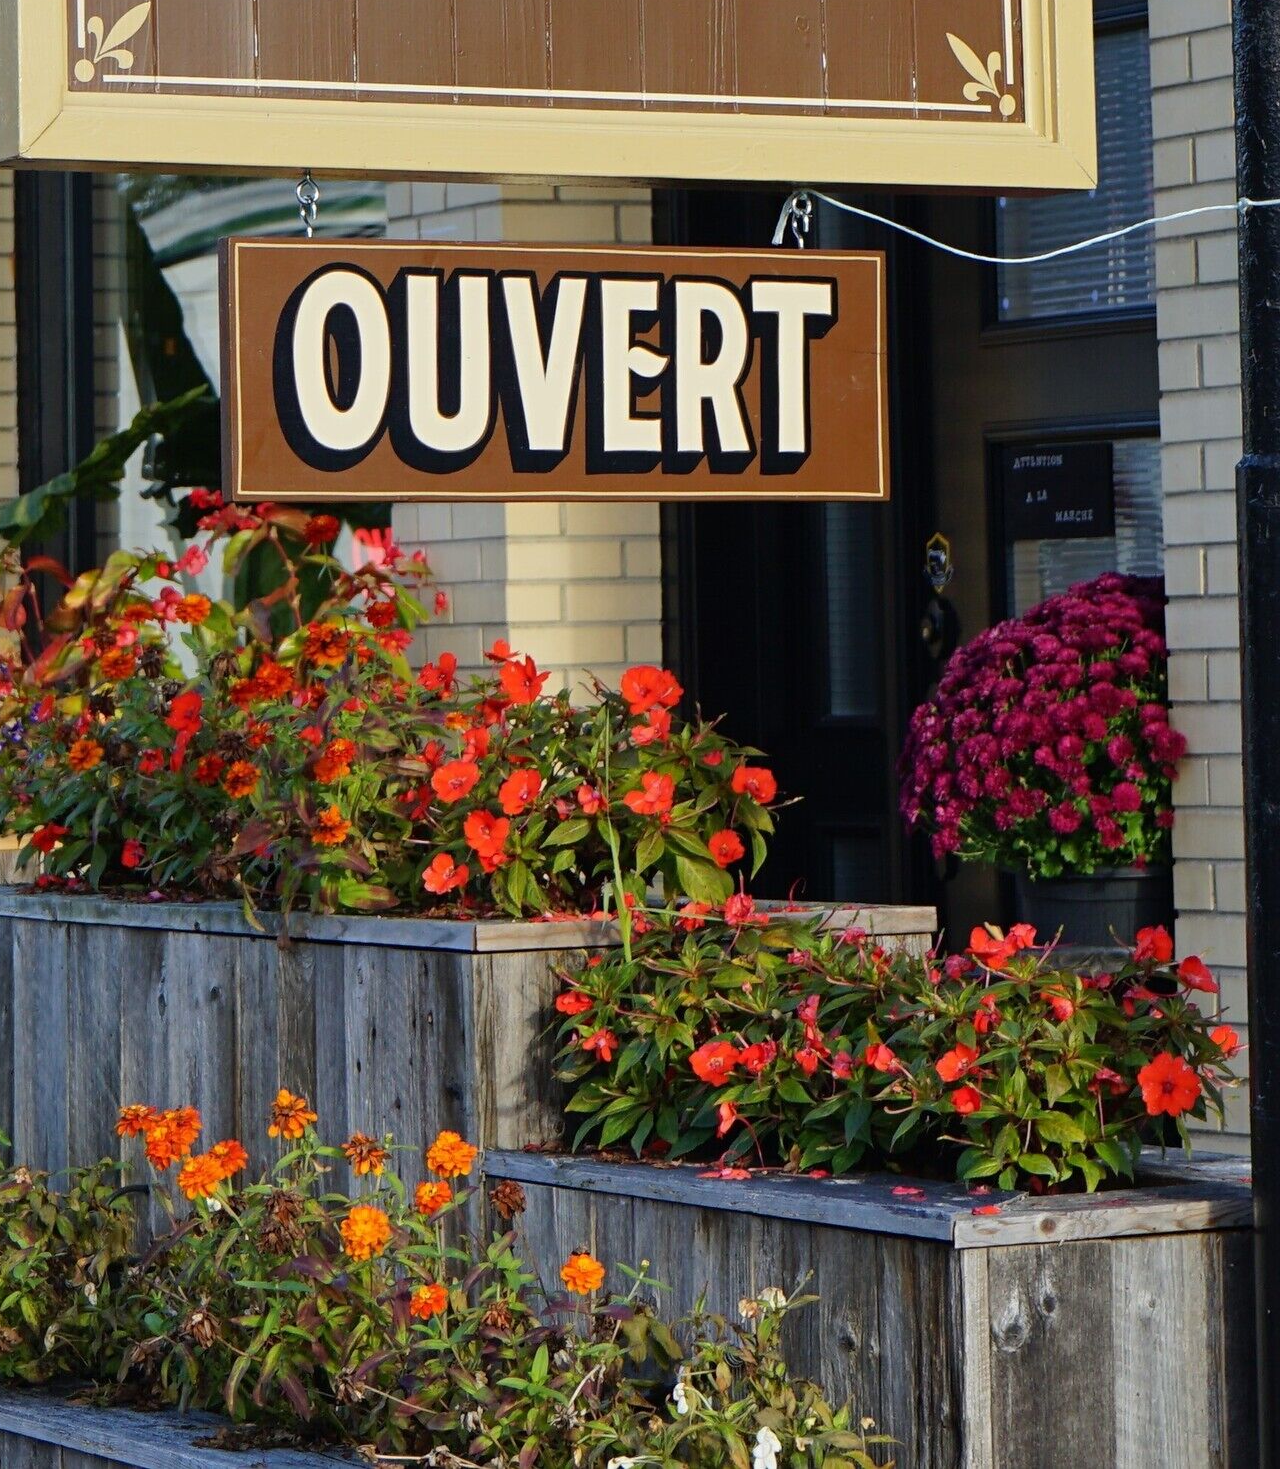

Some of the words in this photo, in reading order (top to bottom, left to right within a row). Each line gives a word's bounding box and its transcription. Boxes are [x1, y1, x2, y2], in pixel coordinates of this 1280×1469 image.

[278, 265, 838, 470] OUVERT
[1013, 454, 1063, 469] ATTENTION
[1036, 489, 1048, 501] LA
[1055, 509, 1094, 522] MARCHE
